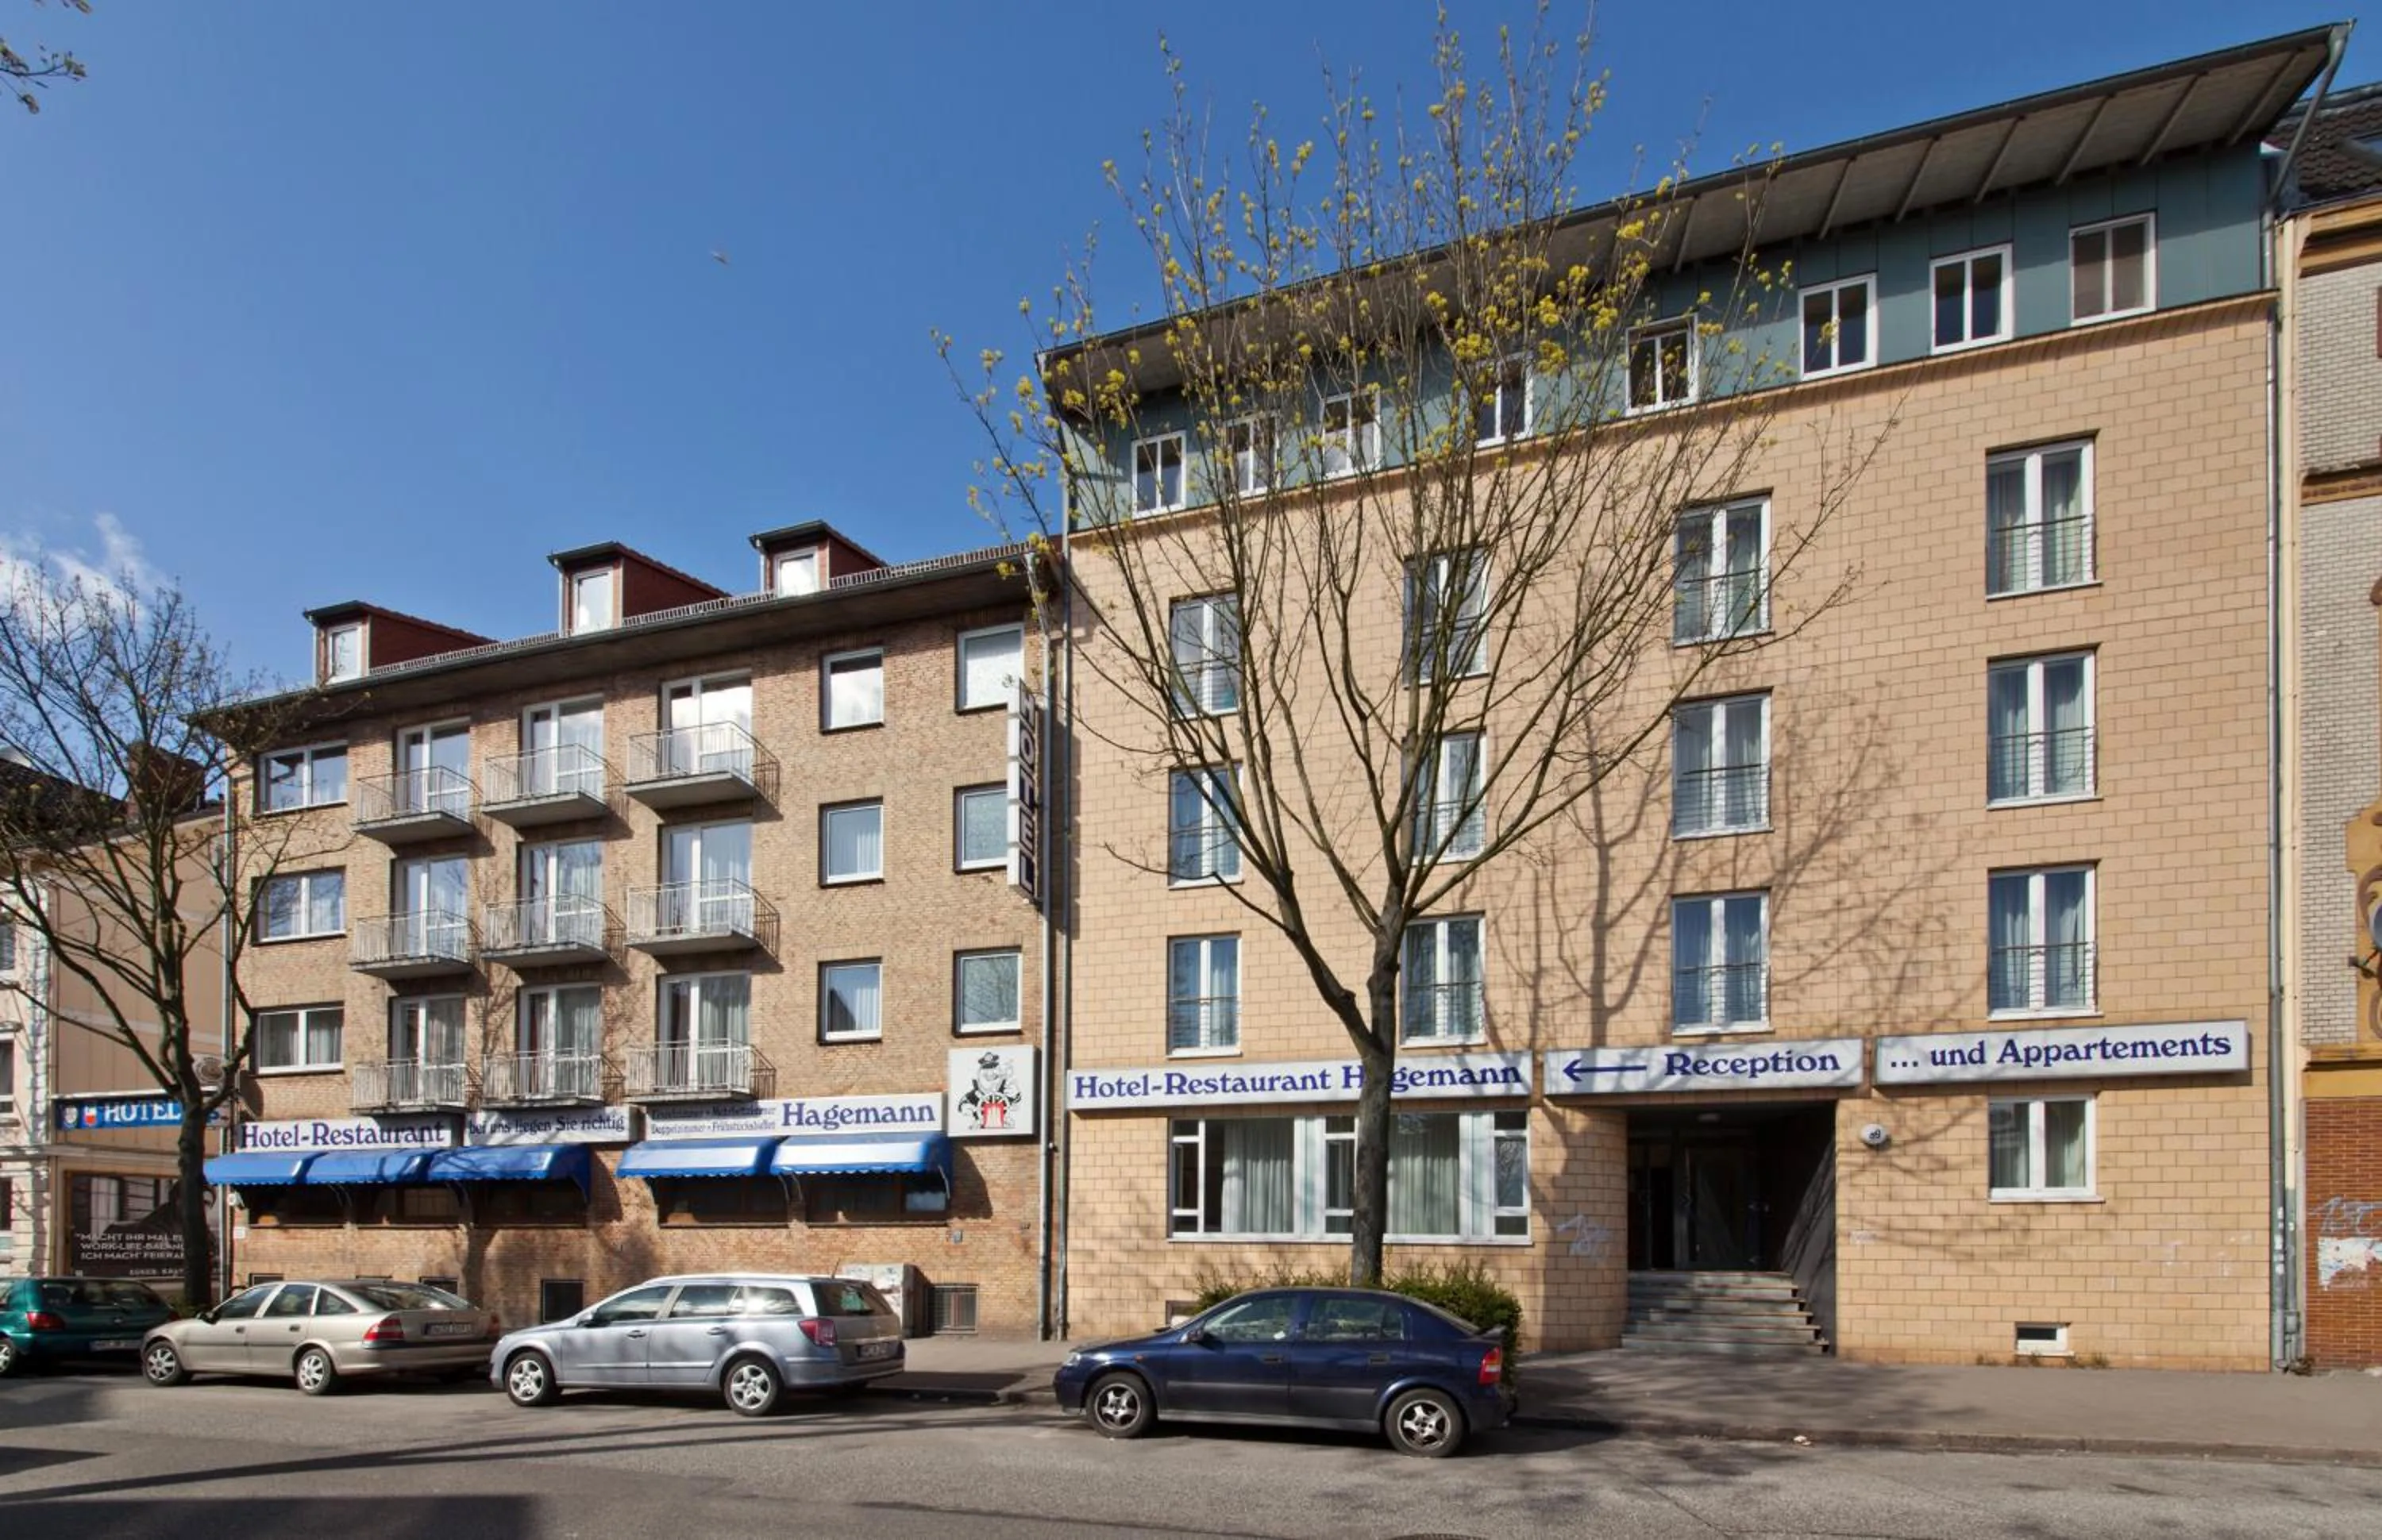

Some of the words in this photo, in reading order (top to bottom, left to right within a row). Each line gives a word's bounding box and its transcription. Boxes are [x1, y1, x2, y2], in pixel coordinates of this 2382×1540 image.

[1019, 679, 1035, 895] HOTEL
[1664, 1049, 1840, 1078] Reception
[1930, 1040, 1986, 1066] und
[1996, 1031, 2232, 1068] Appartements
[1074, 1067, 1331, 1099] Hotel-Restaurant
[1341, 1065, 1522, 1093] Hgemann
[104, 1099, 181, 1122] HOTEL
[468, 1119, 485, 1134] bei
[515, 1117, 552, 1135] liegen
[556, 1115, 577, 1132] Sie
[580, 1112, 626, 1132] richtig
[781, 1102, 935, 1130] Hagemann
[241, 1121, 445, 1149] Hotel-Restaurant
[80, 1242, 184, 1251] WORK-LIFE-BALAN
